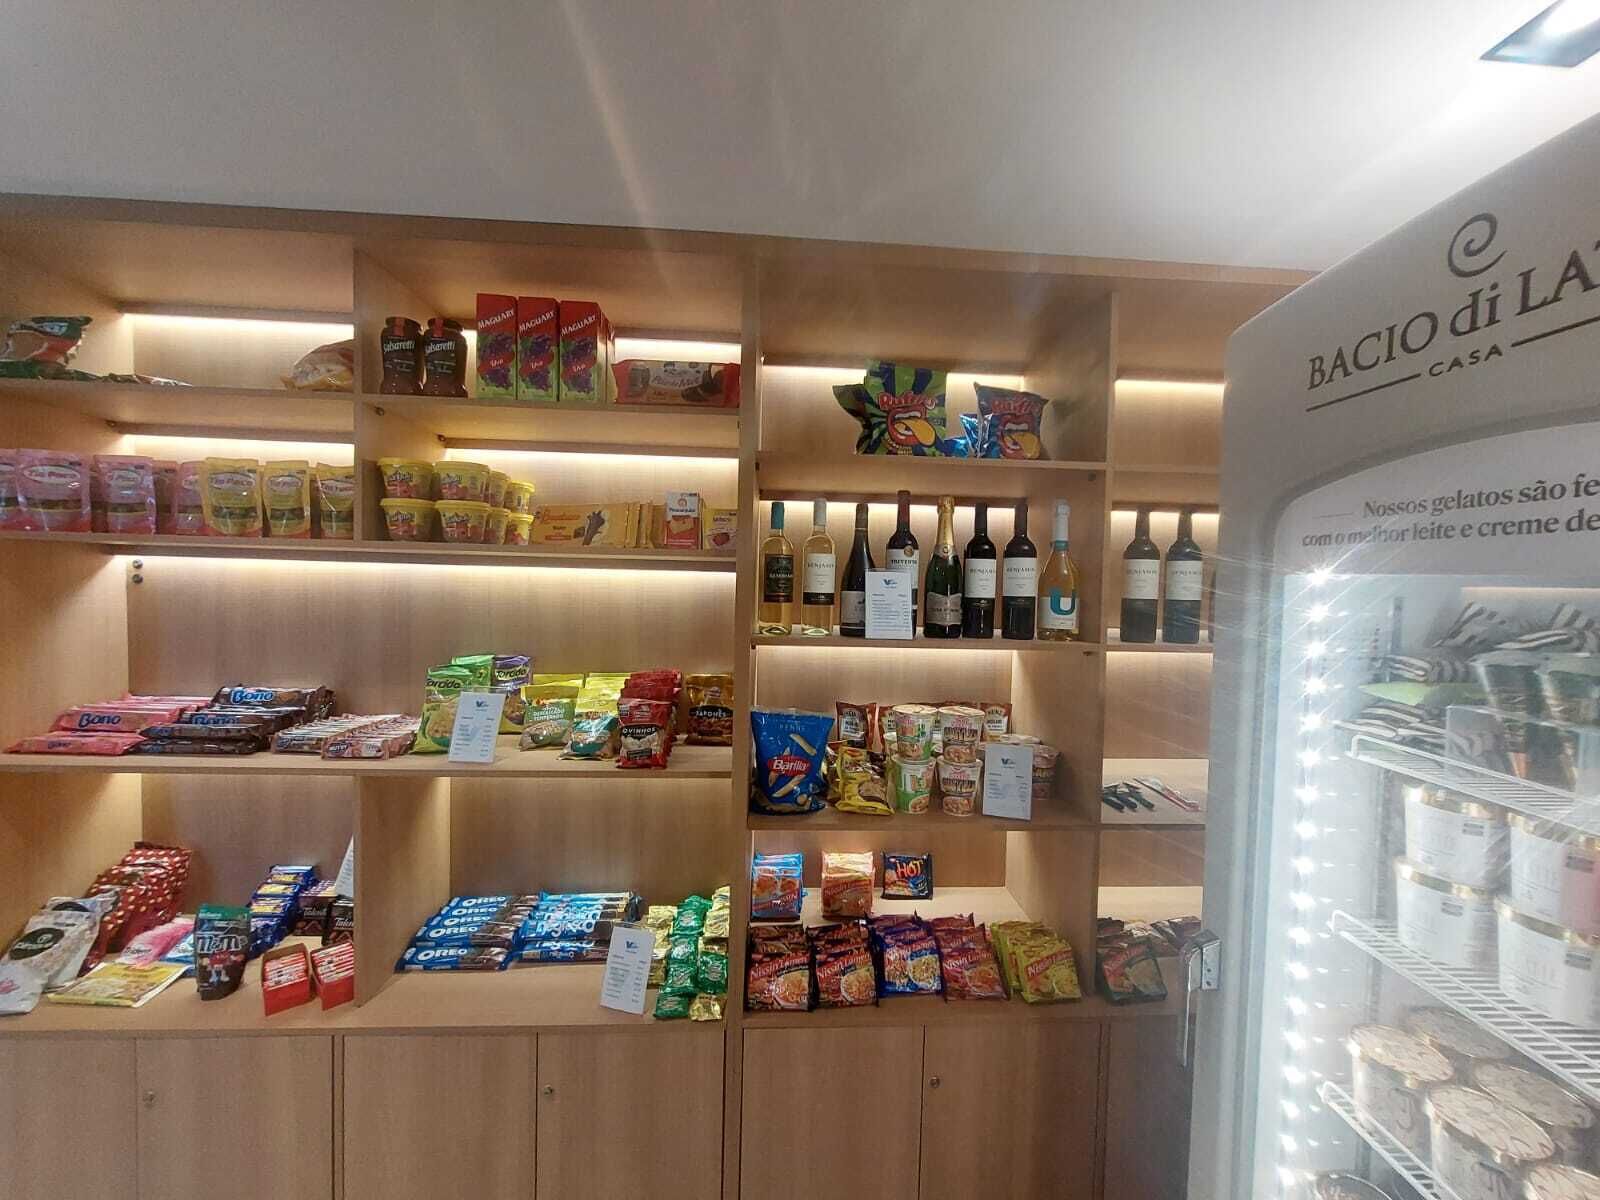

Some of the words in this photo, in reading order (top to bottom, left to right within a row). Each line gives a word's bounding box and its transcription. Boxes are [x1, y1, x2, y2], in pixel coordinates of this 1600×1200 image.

[477, 308, 515, 329] MAGUARY
[519, 310, 555, 333] MAGUARY
[561, 315, 596, 337] MAGUARY
[1307, 311, 1439, 390] BACIO
[1450, 283, 1501, 337] di
[1428, 344, 1503, 377] CASA
[1363, 498, 1428, 518] Nossos
[1431, 487, 1513, 517] gelatos
[1517, 480, 1567, 505] são
[1302, 532, 1332, 547] com
[1347, 525, 1409, 545] melhor
[1412, 518, 1455, 541] leite
[1460, 523, 1473, 538] e
[1477, 515, 1560, 537] creme
[231, 688, 274, 704] Bono
[78, 713, 121, 728] Bono
[773, 758, 809, 773] Barilla
[896, 859, 923, 878] HOT
[462, 896, 506, 906] OREO
[452, 907, 498, 916] OREO
[444, 916, 490, 926] OREO
[429, 926, 478, 938] OREO
[417, 947, 468, 961] OREO
